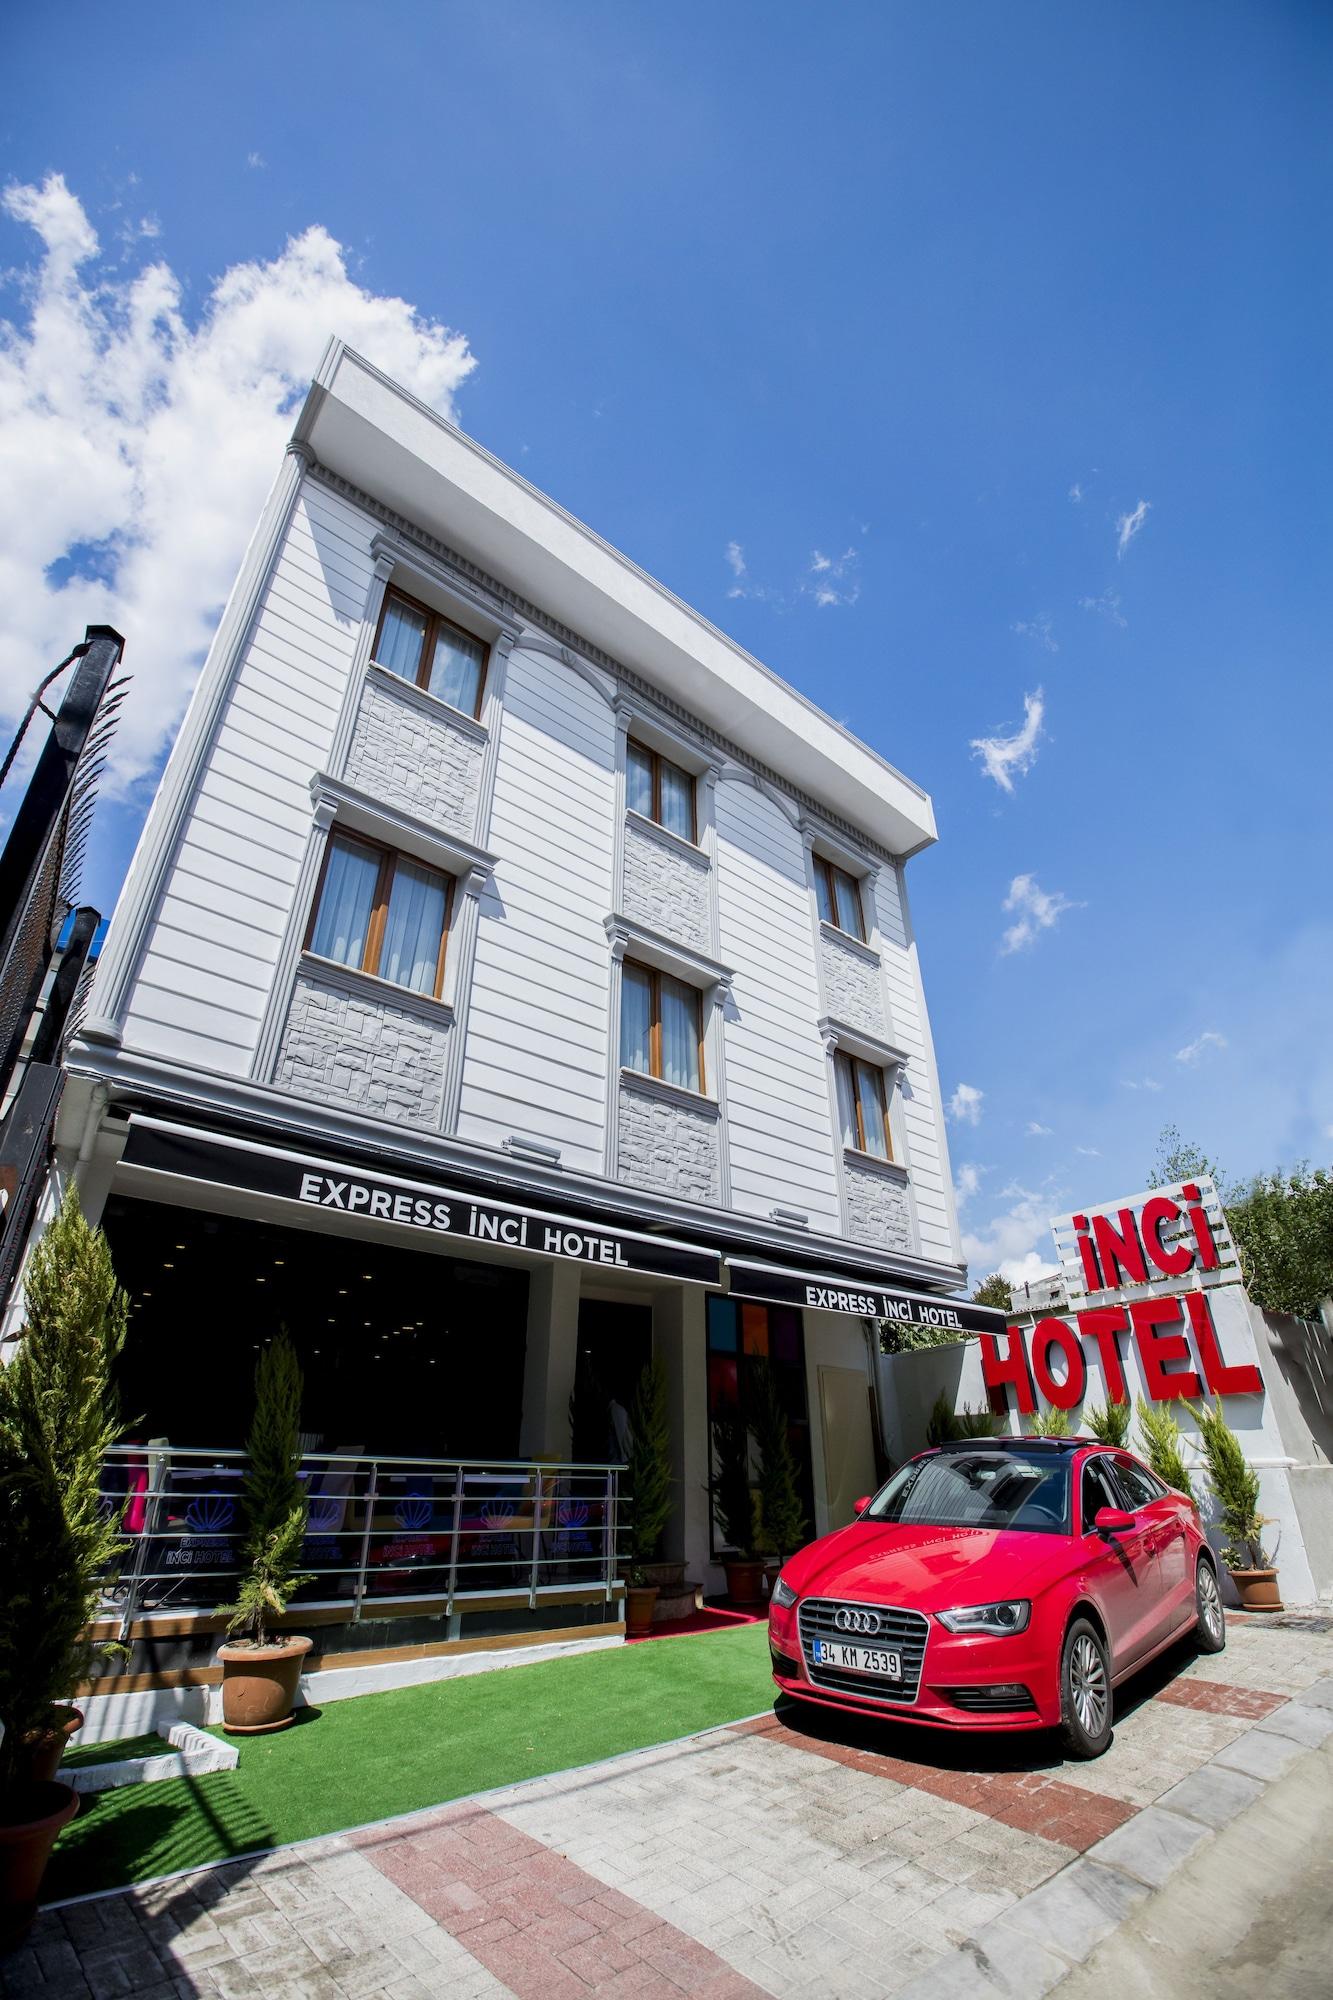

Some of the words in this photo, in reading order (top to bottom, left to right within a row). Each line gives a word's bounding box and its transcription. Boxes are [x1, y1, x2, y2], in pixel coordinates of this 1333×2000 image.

[299, 1173, 451, 1229] EXPRESS
[543, 1227, 629, 1266] HOTEL
[805, 1286, 877, 1315] EXPRESS
[918, 1305, 963, 1329] HOTEL
[979, 1291, 1265, 1416] HOTEL
[821, 1643, 836, 1663] 34
[841, 1647, 858, 1667] KM
[863, 1650, 897, 1673] 2539
